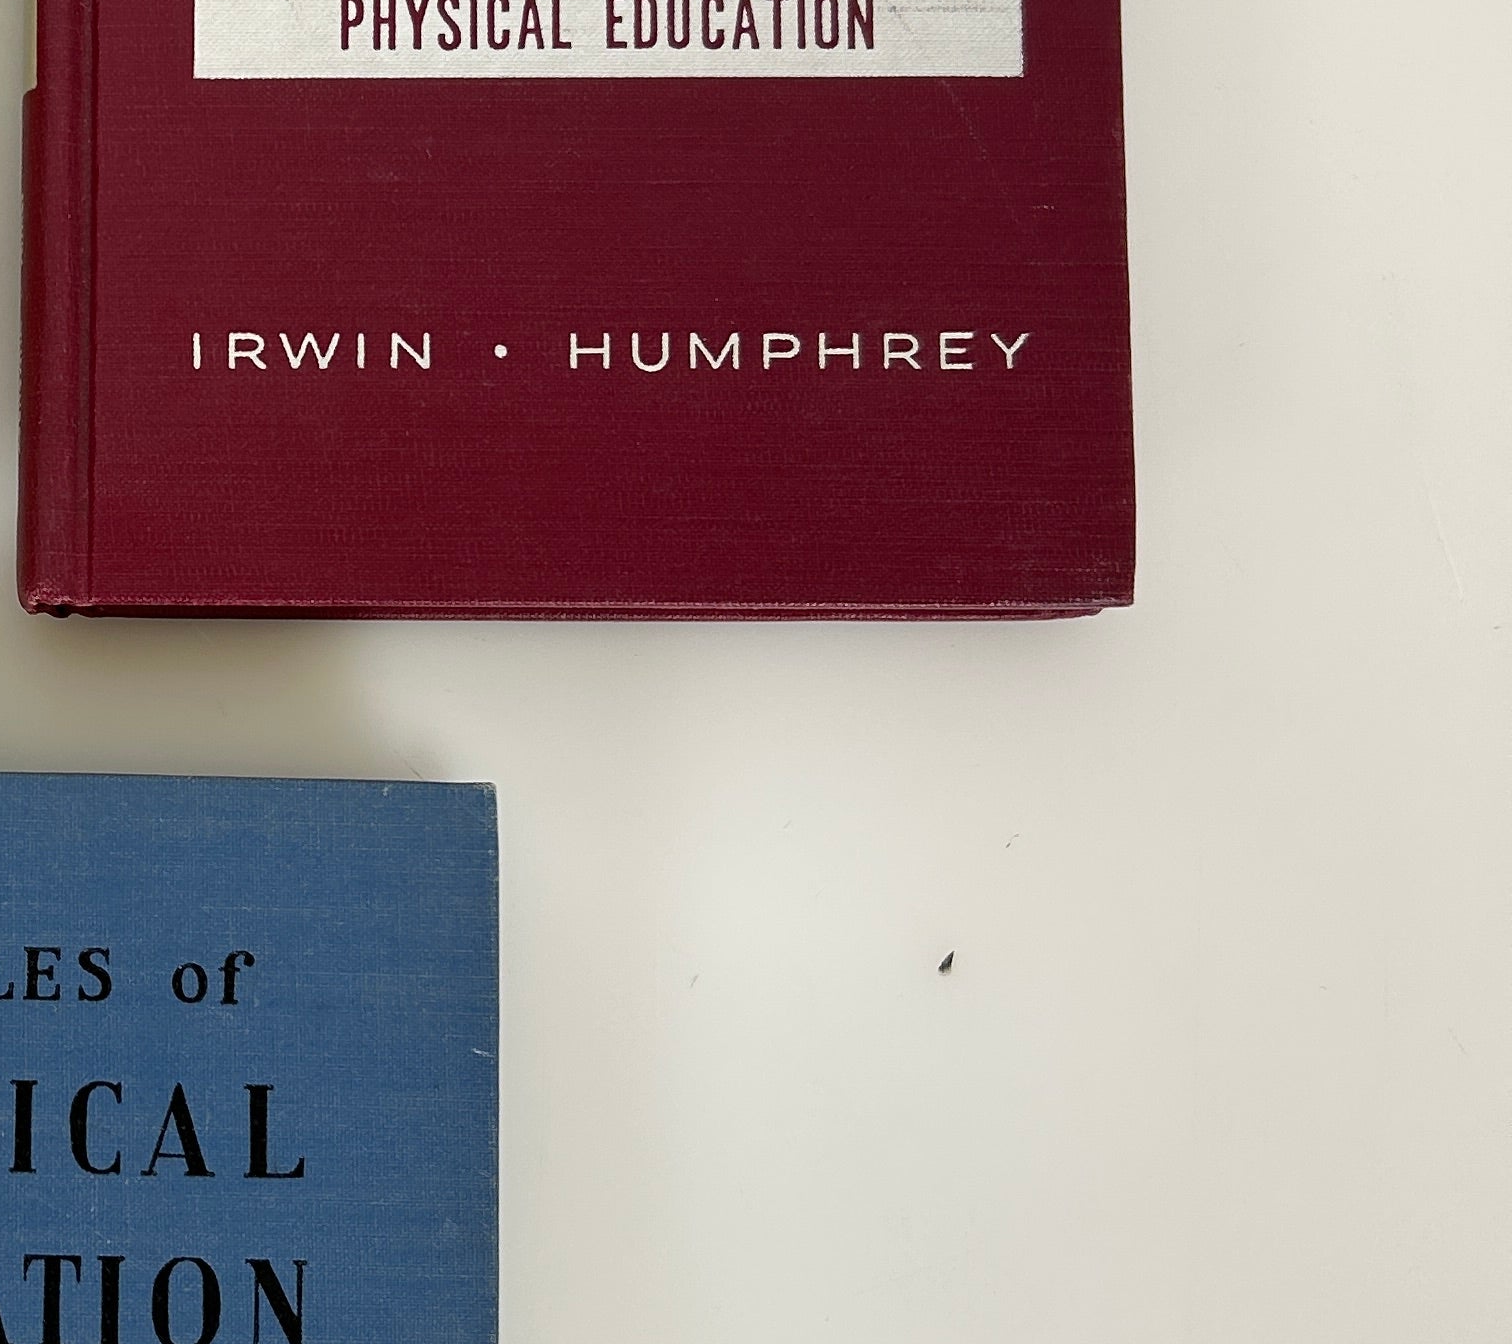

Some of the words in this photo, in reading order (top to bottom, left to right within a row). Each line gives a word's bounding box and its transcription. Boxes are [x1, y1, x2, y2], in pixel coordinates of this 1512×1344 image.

[192, 332, 431, 370] IRWIN
[569, 331, 1029, 373] HUMPHREY
[171, 951, 255, 1005] of
